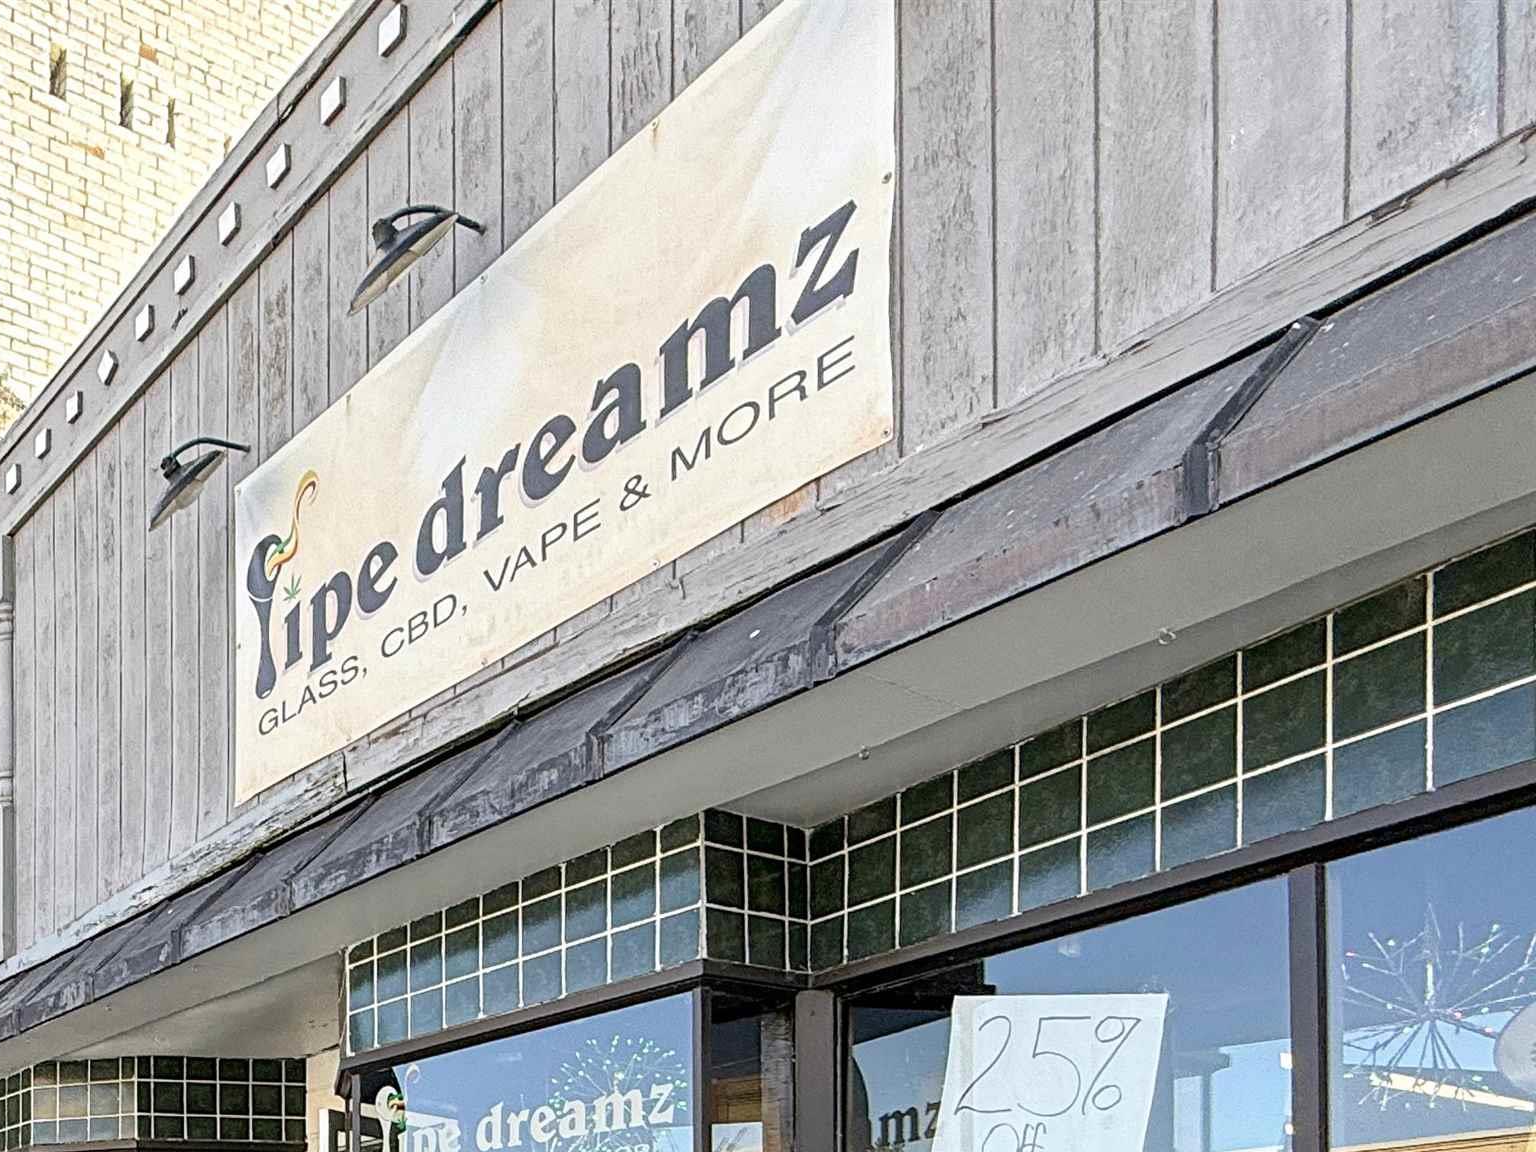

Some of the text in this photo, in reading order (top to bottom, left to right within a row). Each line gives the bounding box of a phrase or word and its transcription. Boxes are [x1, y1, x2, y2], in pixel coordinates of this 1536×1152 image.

[413, 198, 862, 582] dreamz
[257, 335, 856, 737] GLASS, CBD, VAPE & MORE
[476, 1082, 676, 1151] dreamz
[954, 1014, 1142, 1117] 25%
